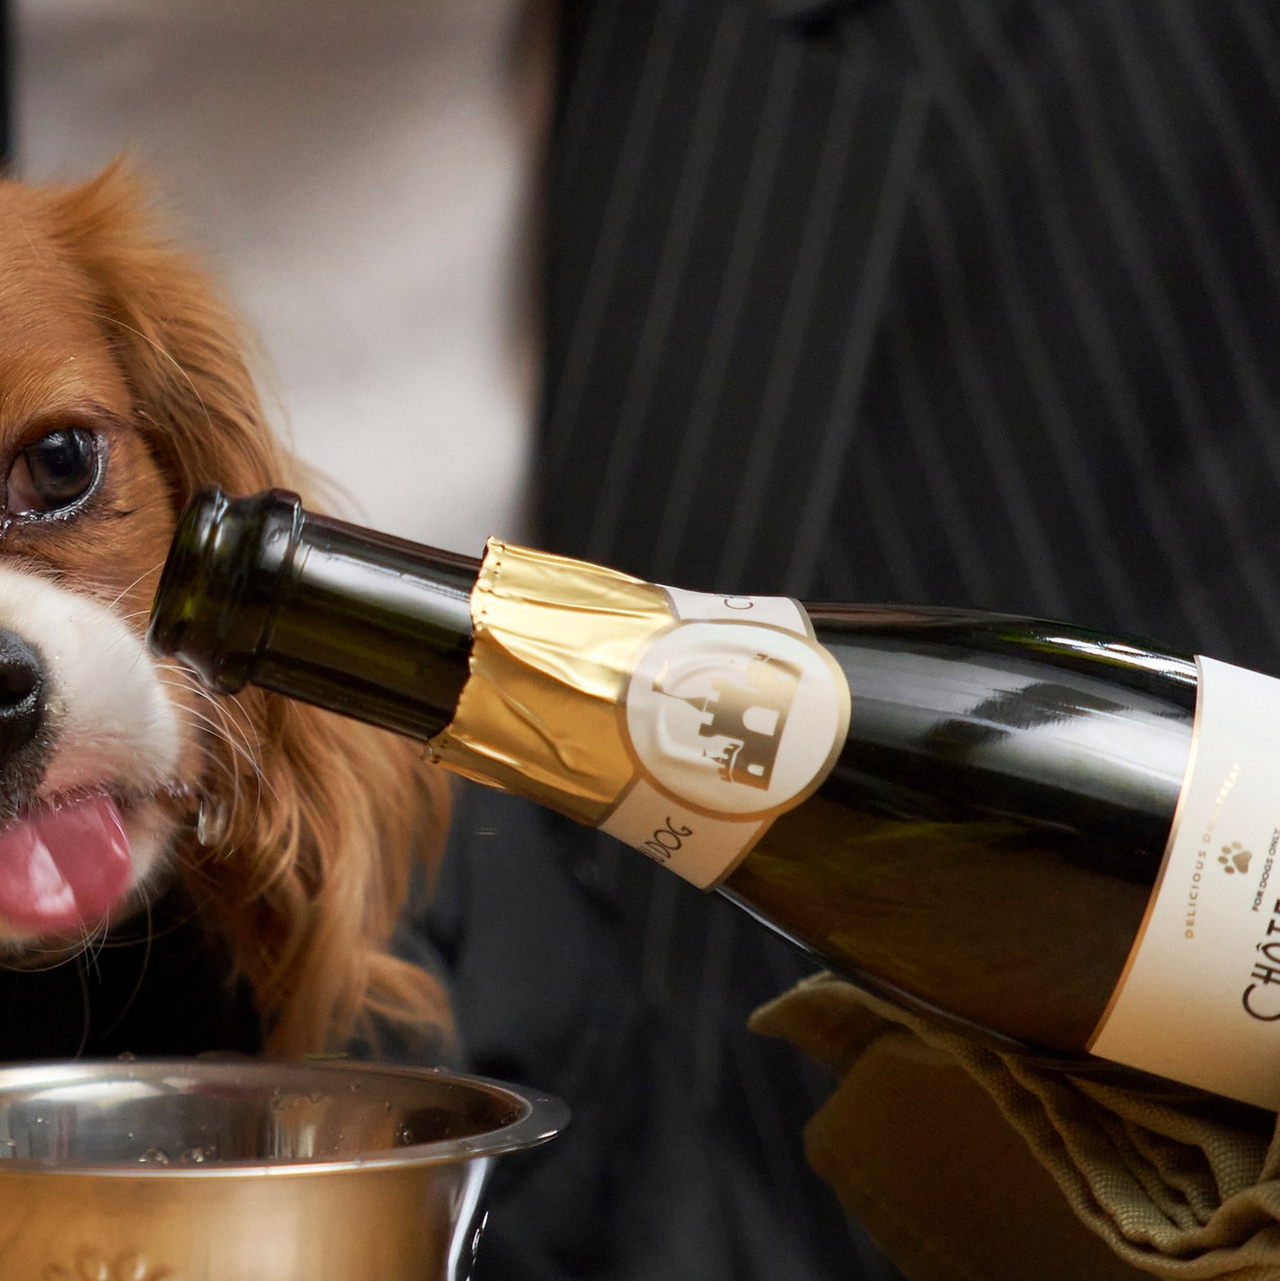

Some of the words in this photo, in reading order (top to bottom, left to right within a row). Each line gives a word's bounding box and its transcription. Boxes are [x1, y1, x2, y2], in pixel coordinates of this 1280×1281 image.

[1184, 849, 1207, 939] DELICIOUS
[1202, 810, 1221, 844] DO
[1215, 763, 1241, 805] TREAT
[1252, 890, 1265, 912] FOR
[1259, 857, 1274, 889] DOGS
[1268, 828, 1280, 856] ONLY
